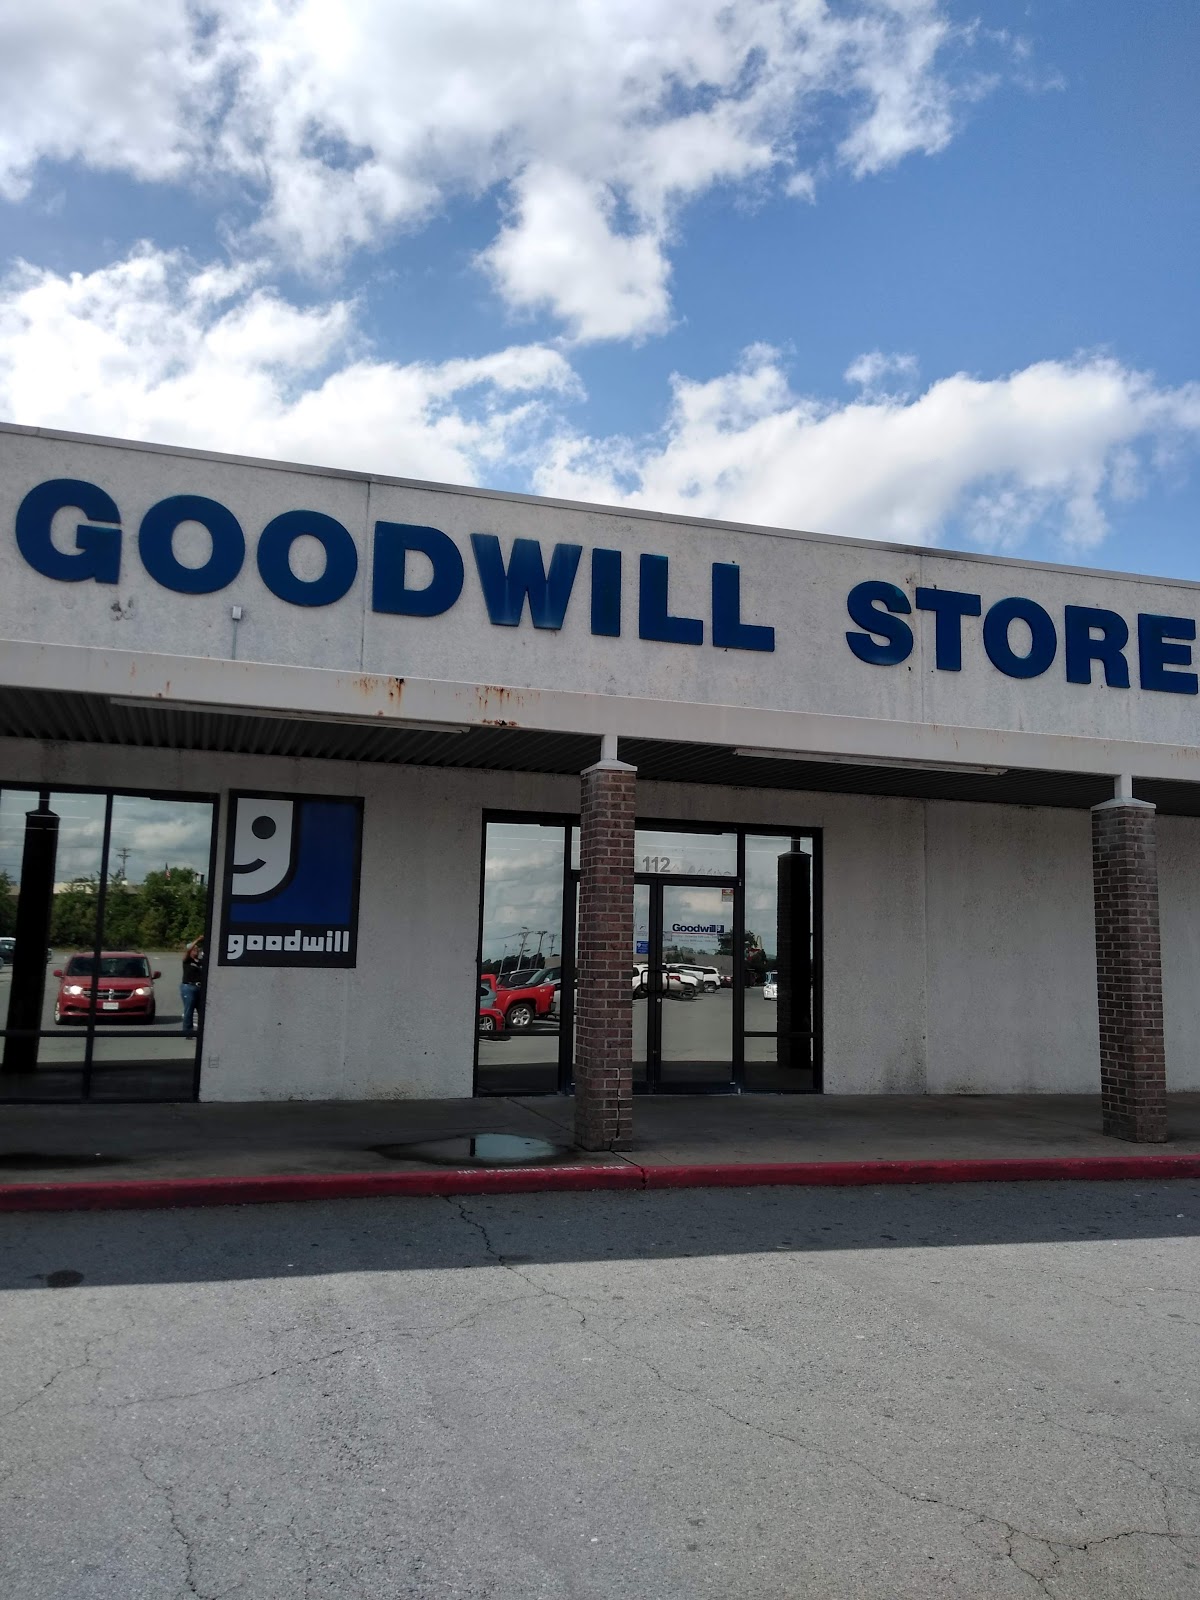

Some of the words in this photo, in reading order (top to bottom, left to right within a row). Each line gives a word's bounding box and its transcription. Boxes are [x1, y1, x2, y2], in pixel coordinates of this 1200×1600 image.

[15, 478, 775, 652] GOODWILL
[846, 580, 1198, 695] STORE
[642, 856, 671, 873] 112
[672, 923, 717, 933] Goodwill
[227, 929, 350, 960] goodwill
